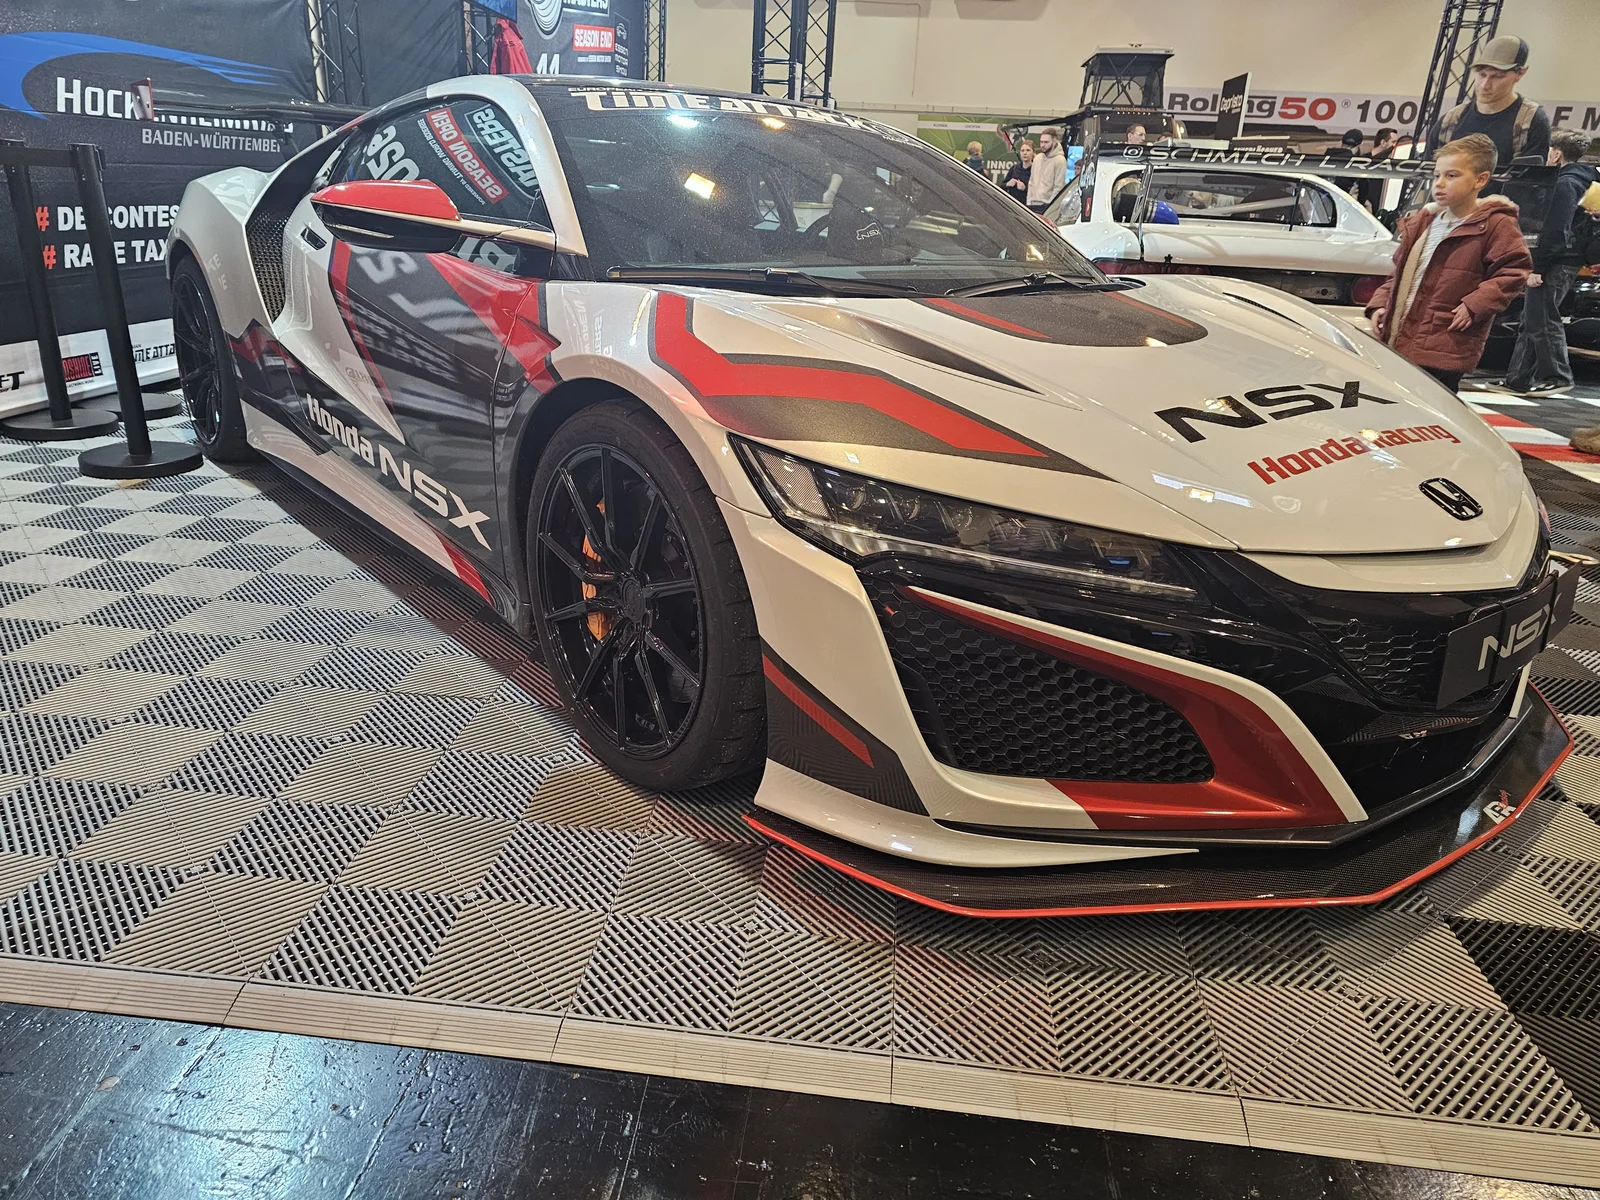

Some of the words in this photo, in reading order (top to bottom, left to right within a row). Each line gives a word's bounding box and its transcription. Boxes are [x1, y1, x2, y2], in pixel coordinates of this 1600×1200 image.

[575, 28, 600, 47] SEASON
[600, 30, 613, 48] END
[1166, 92, 1337, 121] Rolng50
[142, 128, 281, 153] BADEN-WÜRTTEMBE
[986, 160, 1018, 171] INNO
[107, 205, 180, 229] ONTES
[63, 243, 126, 269] RAE
[131, 239, 168, 263] TAX
[1154, 380, 1399, 443] NSX
[306, 392, 376, 467] Honda
[378, 443, 492, 552] NSX
[1247, 435, 1371, 485] Honda
[1477, 592, 1562, 672] NSX
